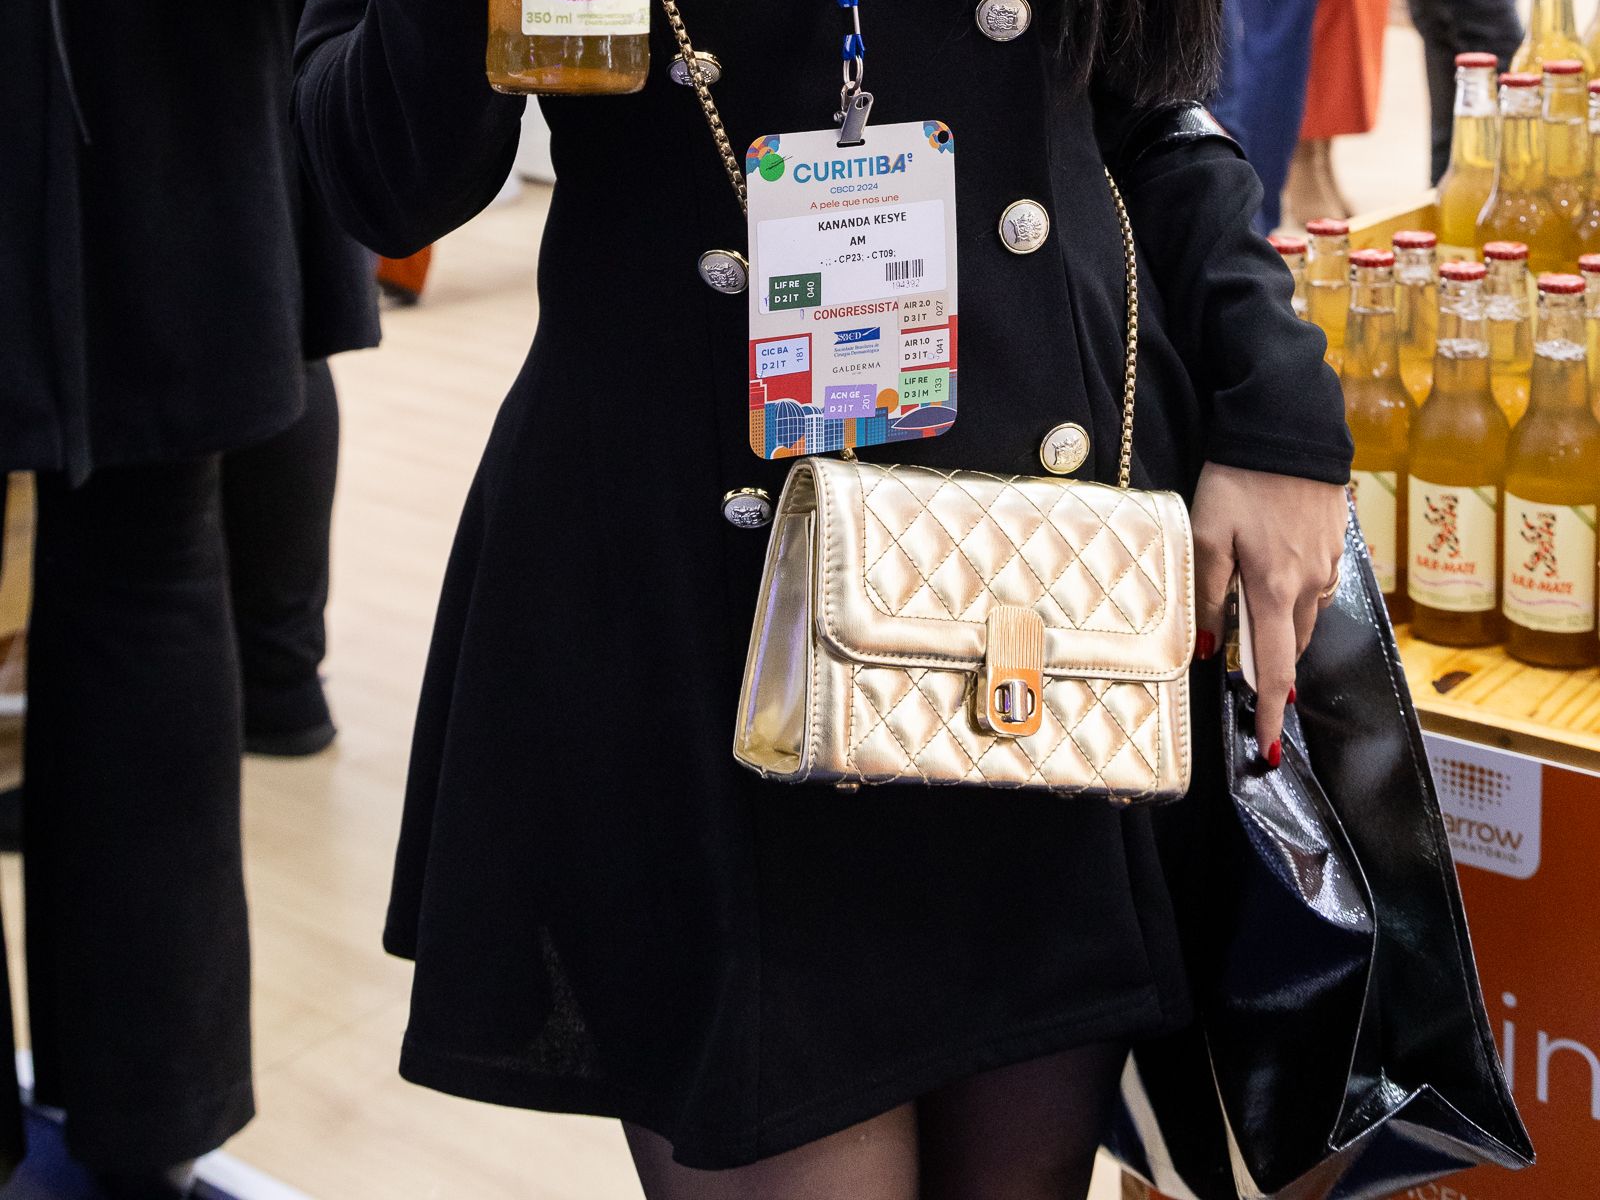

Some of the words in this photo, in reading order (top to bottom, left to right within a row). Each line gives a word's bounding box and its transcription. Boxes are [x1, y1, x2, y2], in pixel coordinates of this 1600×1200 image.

[526, 12, 551, 23] 350
[556, 12, 572, 24] ml
[793, 154, 906, 183] CURITIBA
[830, 185, 855, 194] CBCD
[857, 182, 878, 191] 2024
[810, 202, 818, 210] A
[820, 199, 840, 210] pele
[842, 198, 860, 207] que
[862, 196, 879, 204] nos
[881, 194, 899, 203] une
[818, 217, 870, 231] KANANDA
[874, 212, 907, 224] KESYE
[850, 235, 866, 246] AM
[774, 281, 787, 289] LIF
[789, 280, 799, 288] RE
[807, 281, 815, 298] 040
[904, 301, 917, 309] AIR
[919, 299, 930, 307] 2.0
[814, 301, 899, 320] CONGRESSISTA
[904, 339, 918, 347] AIR
[920, 337, 930, 345] 1.0
[936, 338, 944, 354] 041
[761, 348, 775, 356] CIC
[777, 346, 788, 354] BA
[832, 362, 881, 373] GALDERMA
[918, 376, 928, 384] RE
[934, 377, 942, 393] 133
[862, 394, 870, 410] 201
